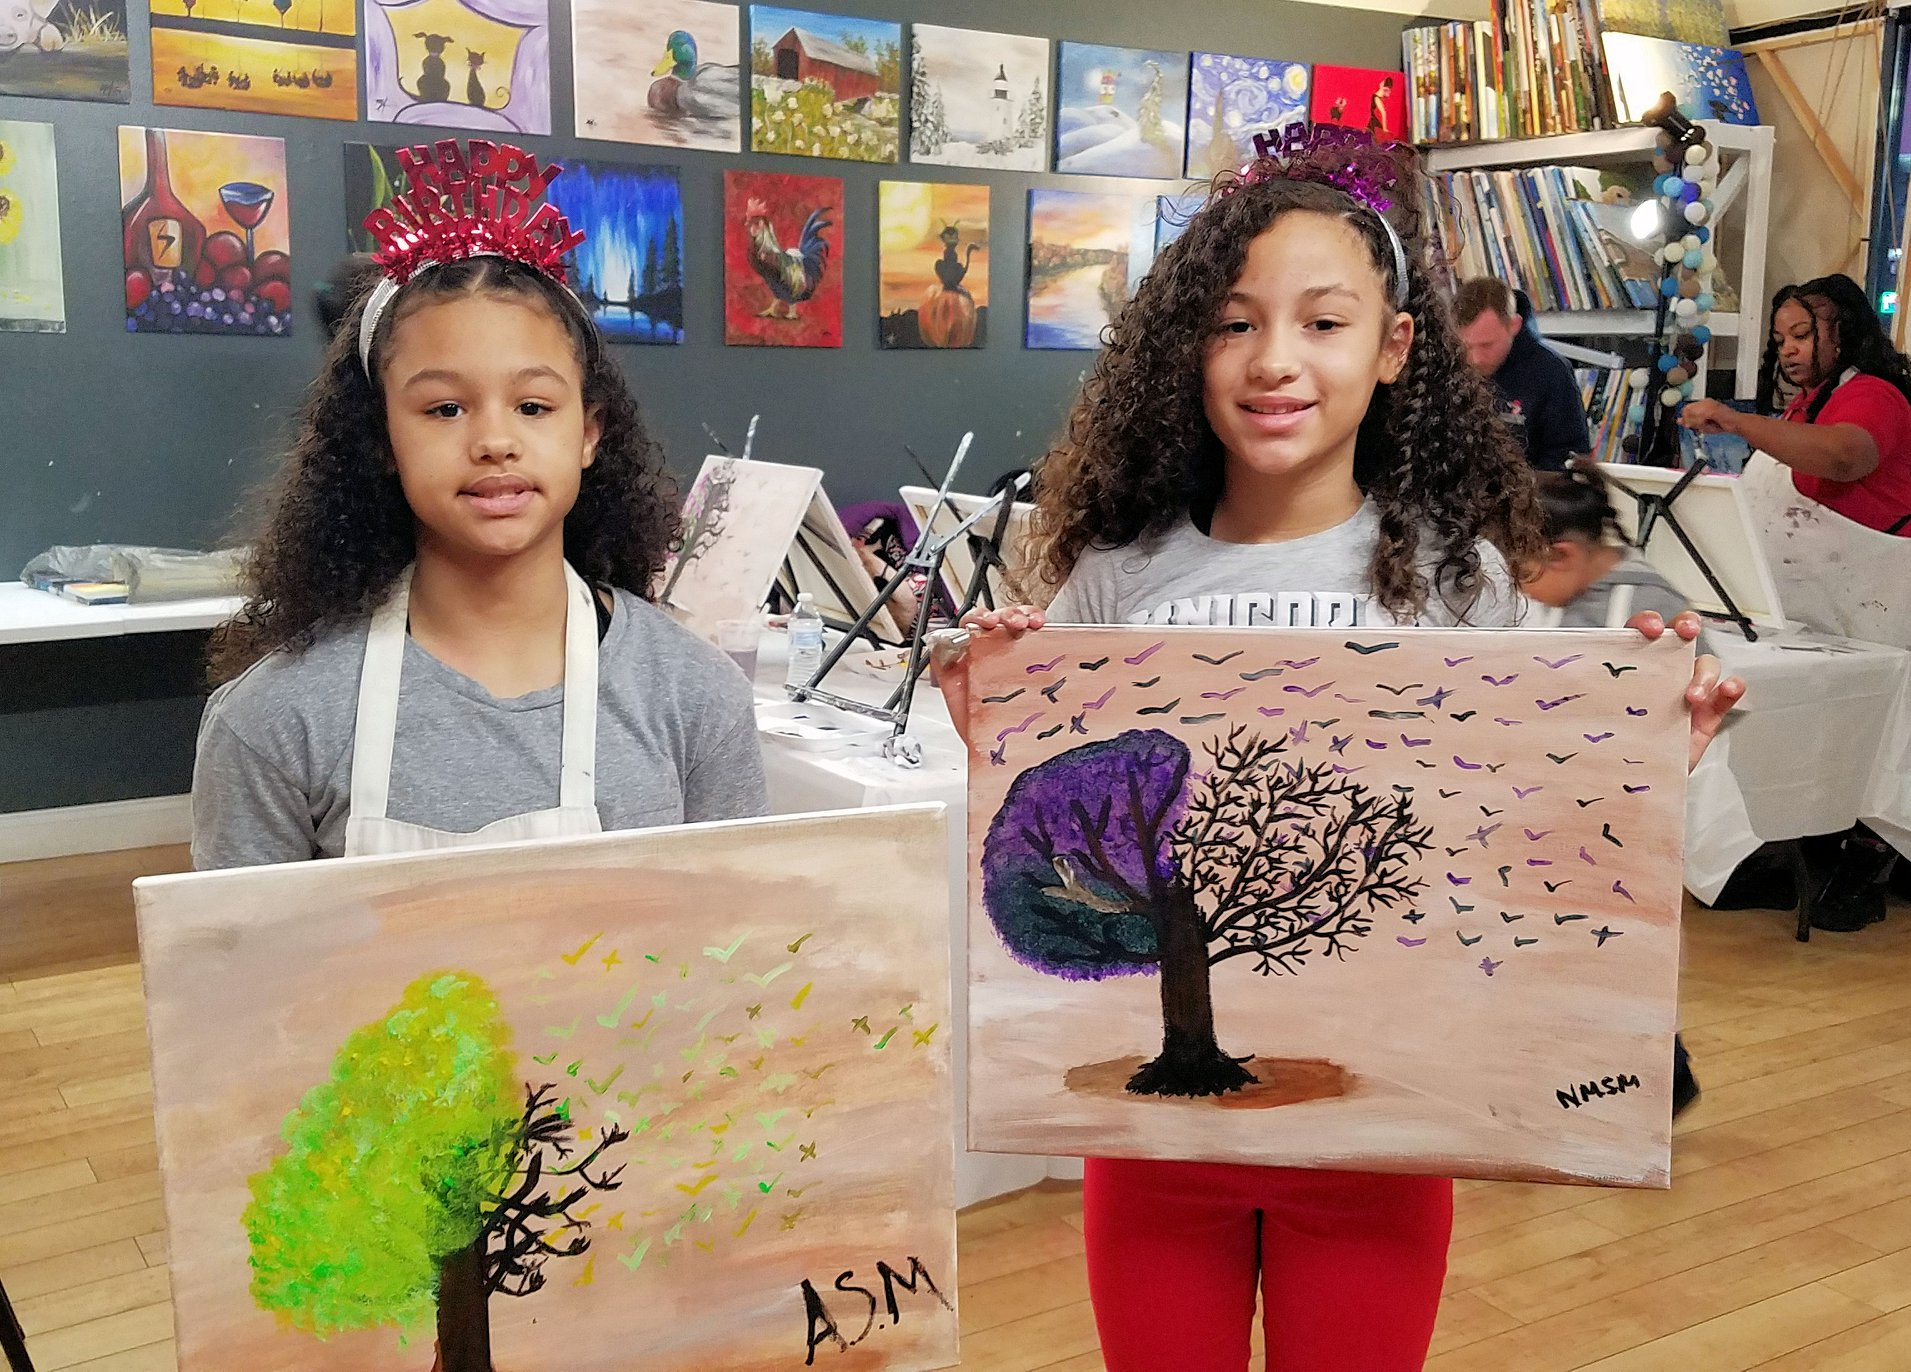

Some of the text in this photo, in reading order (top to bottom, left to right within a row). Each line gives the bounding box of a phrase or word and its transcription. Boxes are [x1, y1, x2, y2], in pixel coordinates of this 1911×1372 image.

[395, 138, 565, 203] HAPPY
[362, 180, 587, 260] BIRTHDAY
[1556, 1073, 1640, 1109] NMSM
